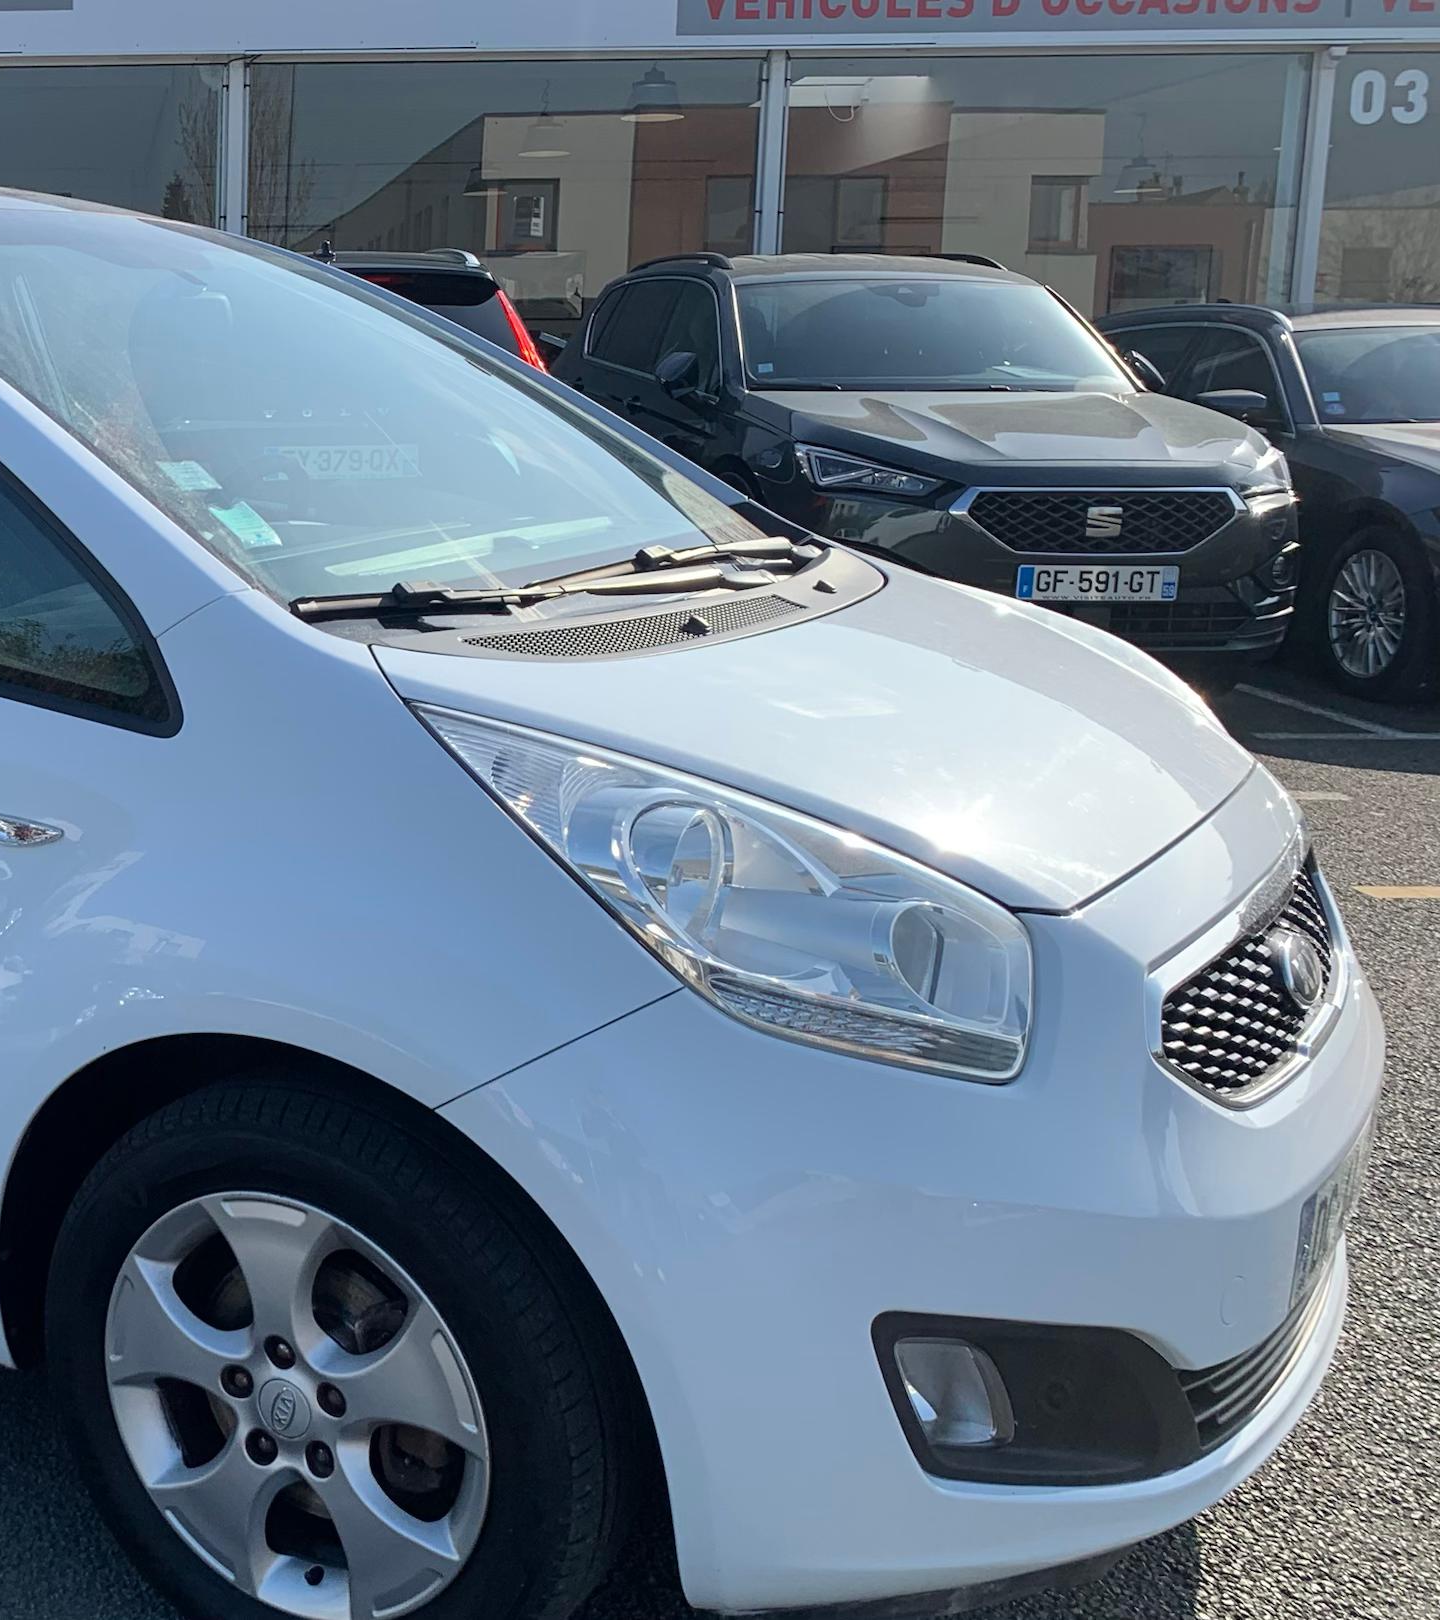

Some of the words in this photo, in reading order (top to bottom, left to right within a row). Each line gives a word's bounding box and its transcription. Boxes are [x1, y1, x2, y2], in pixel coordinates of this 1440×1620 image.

[1350, 69, 1430, 125] 03
[280, 449, 400, 472] Y-379-QX
[1035, 570, 1160, 593] GF-591-GT
[274, 1397, 293, 1424] KIA
